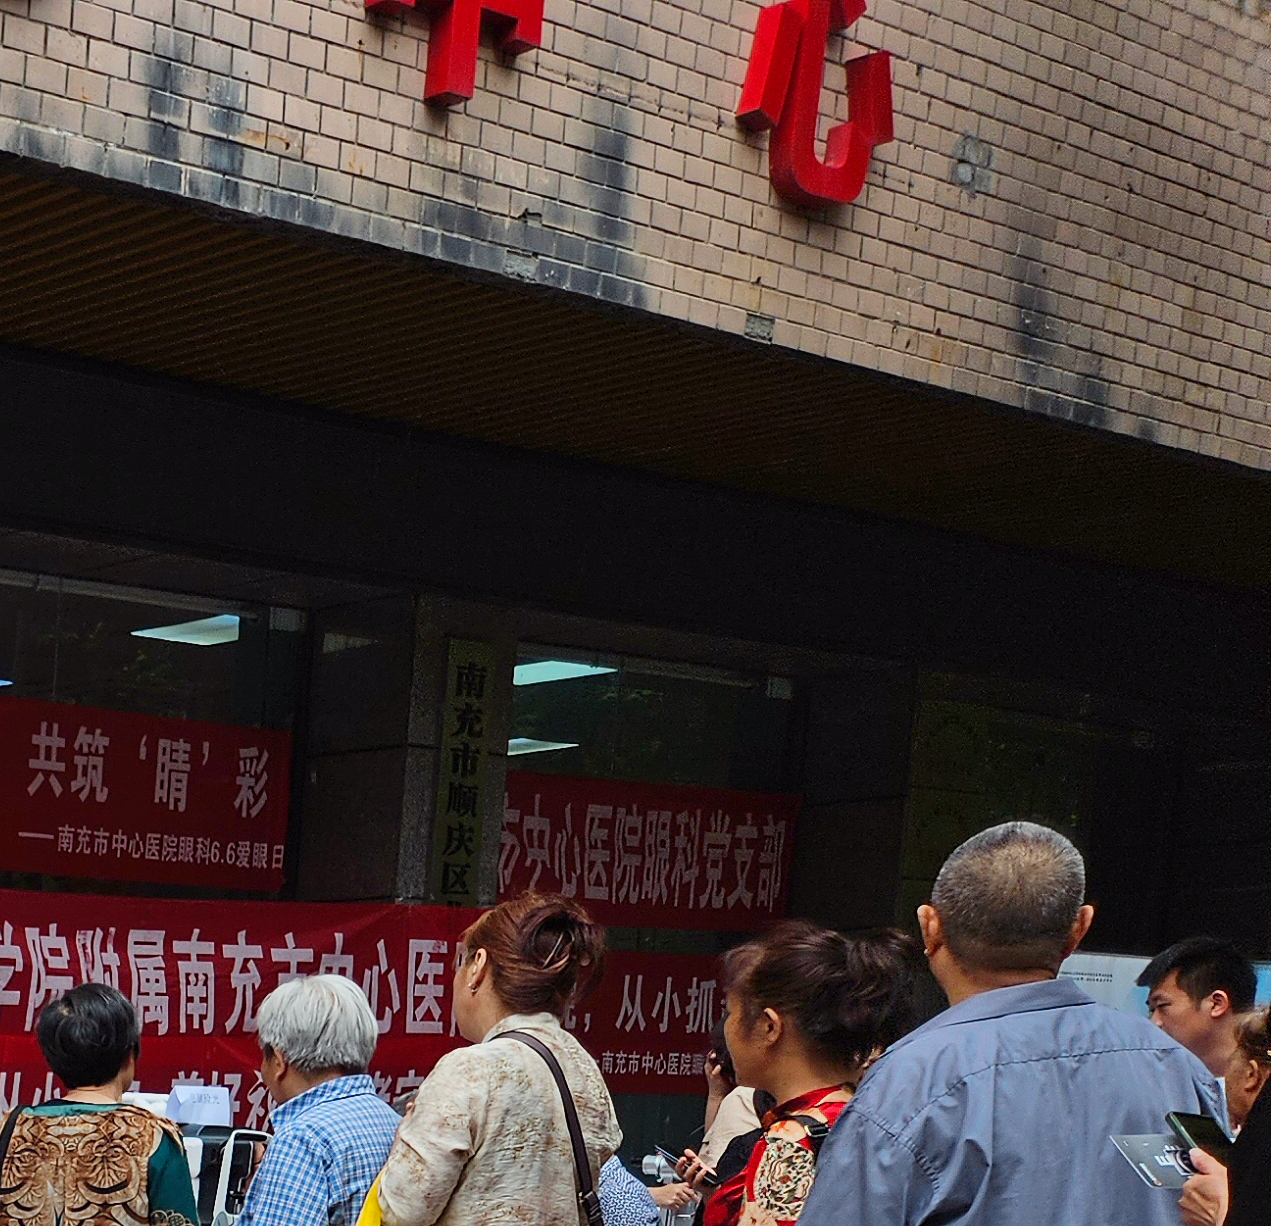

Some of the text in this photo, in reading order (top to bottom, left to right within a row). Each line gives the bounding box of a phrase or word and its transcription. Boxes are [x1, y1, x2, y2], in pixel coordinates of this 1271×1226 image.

[440, 661, 487, 907] 南充市顺庆区
